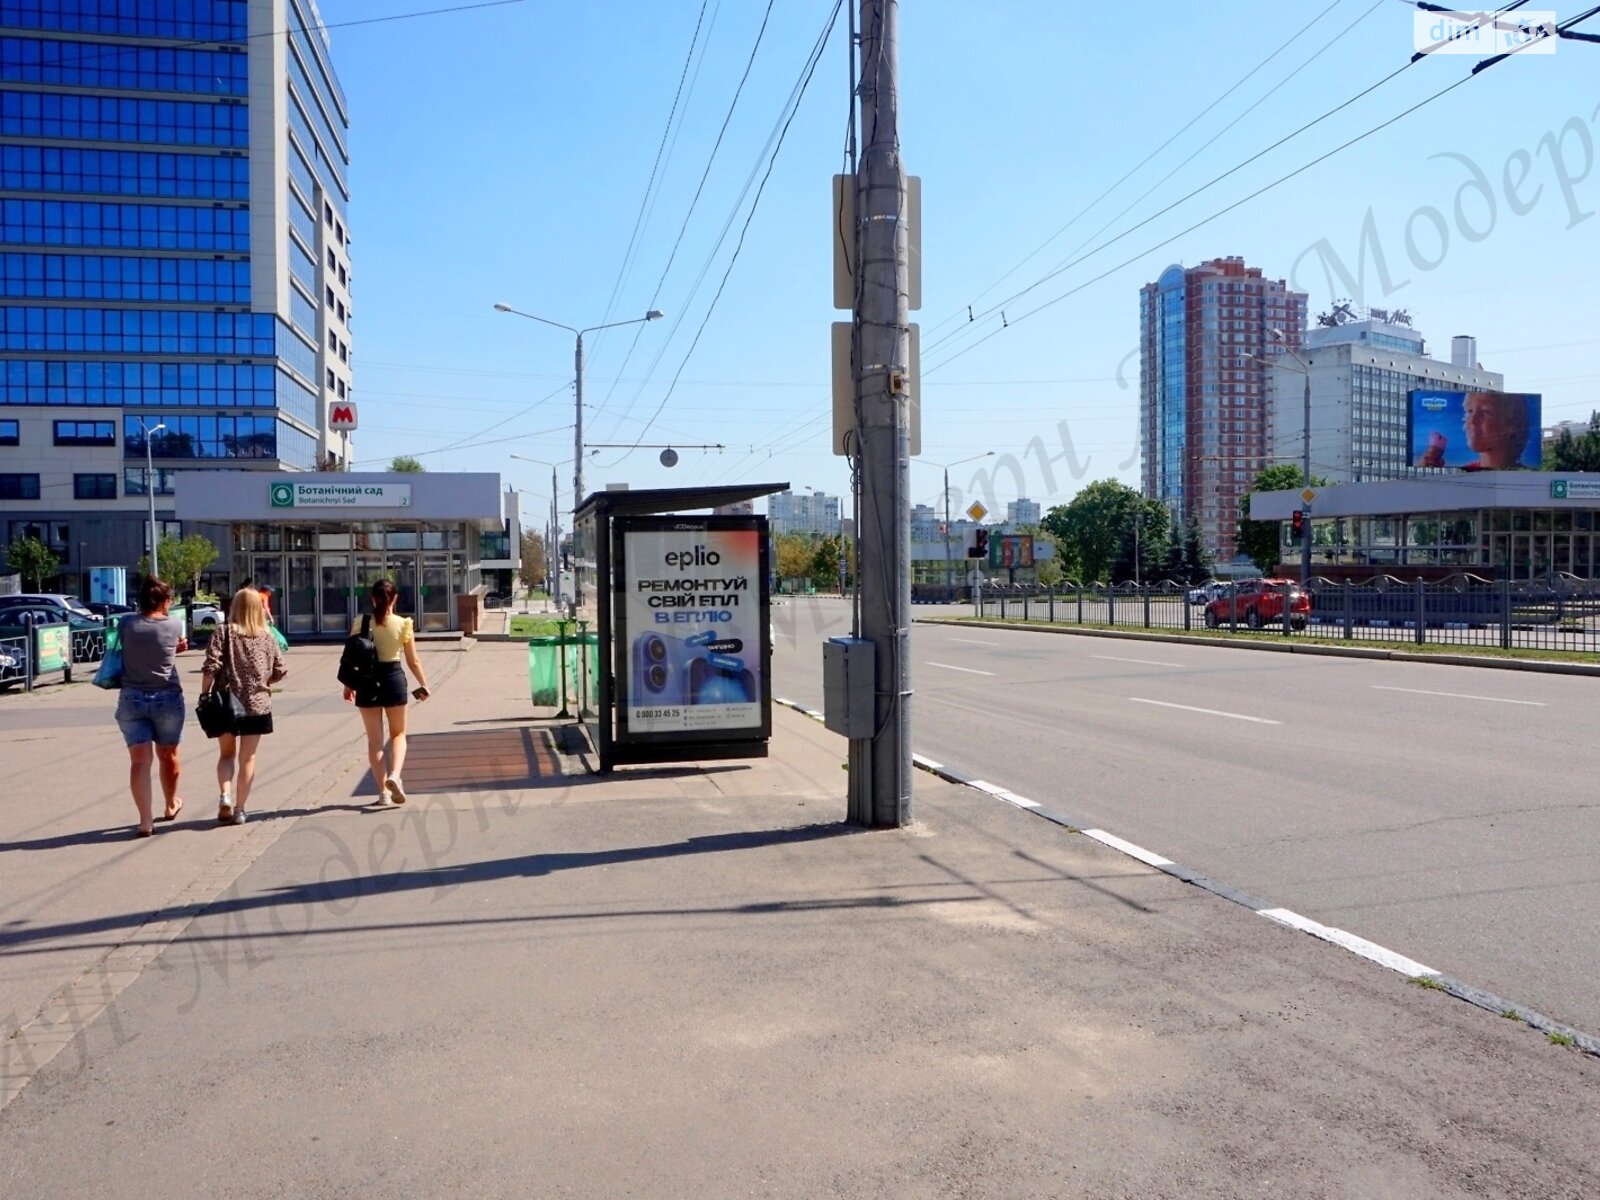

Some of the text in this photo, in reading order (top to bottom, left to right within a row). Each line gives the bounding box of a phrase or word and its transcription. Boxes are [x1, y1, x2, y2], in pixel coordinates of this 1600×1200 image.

[298, 485, 384, 496] Ботанічний сад
[298, 496, 356, 505] Botanichnyi Sad
[402, 497, 408, 505] 2
[665, 545, 720, 571] eplio
[637, 576, 748, 592] РЕМОНТУЙ
[647, 592, 739, 608] СВІЙ ЕПЛ
[655, 612, 669, 624] В
[642, 710, 653, 718] 800
[663, 709, 671, 717] 45
